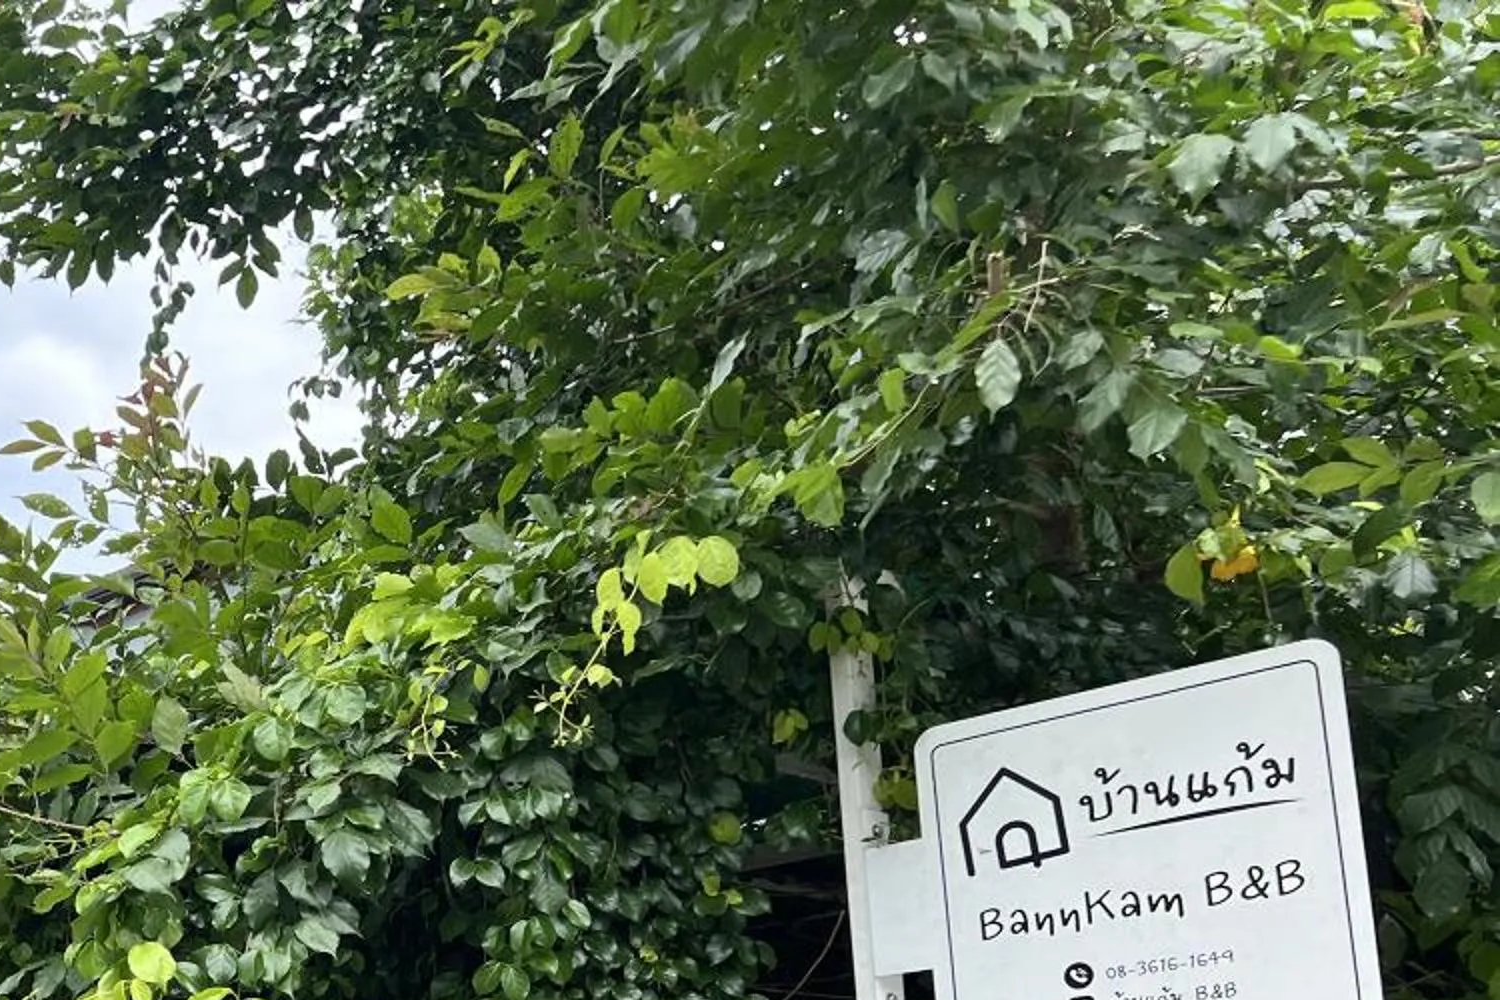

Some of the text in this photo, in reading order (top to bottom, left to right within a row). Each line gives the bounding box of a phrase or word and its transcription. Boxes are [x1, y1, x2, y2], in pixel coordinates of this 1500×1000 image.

[1079, 741, 1296, 823] บ้านแก้ม
[979, 858, 1306, 941] BannKam B&B
[1105, 949, 1235, 980] 08-3616-1649
